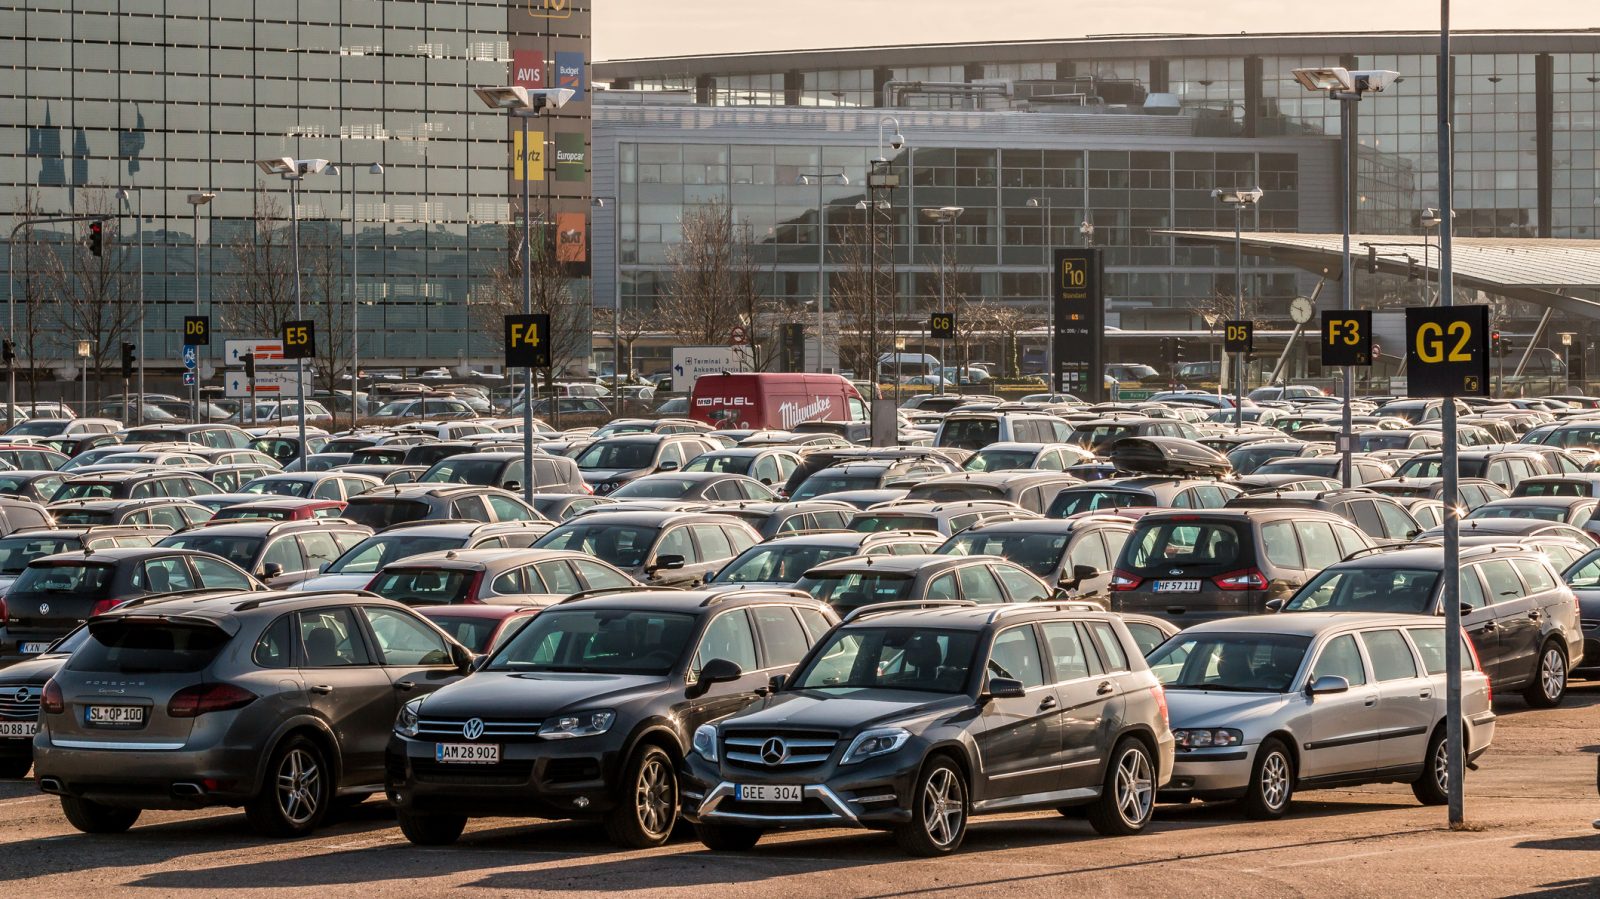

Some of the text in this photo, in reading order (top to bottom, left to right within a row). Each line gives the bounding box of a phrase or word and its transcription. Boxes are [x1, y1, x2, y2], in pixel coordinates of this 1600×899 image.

[517, 68, 540, 82] AVIS
[560, 66, 579, 77] Budget
[516, 149, 541, 161] Hrtz
[556, 149, 584, 163] Europcar
[1065, 261, 1073, 274] P
[1070, 269, 1085, 286] 10
[186, 320, 204, 335] D6
[933, 316, 950, 330] C6
[286, 326, 308, 345] E5
[511, 323, 540, 348] F4
[1227, 325, 1248, 341] D5
[1329, 319, 1360, 346] F3
[1415, 320, 1472, 364] G2
[693, 357, 721, 365] Terminal
[713, 396, 754, 406] FUEL
[778, 395, 831, 430] Milwaukee
[1158, 581, 1198, 590] HF 57 111
[24, 642, 40, 650] KXN
[90, 707, 142, 720] SL OP 100
[11, 723, 23, 735] 88
[444, 746, 497, 759] AM 28 902
[742, 786, 799, 800] GEE 304
